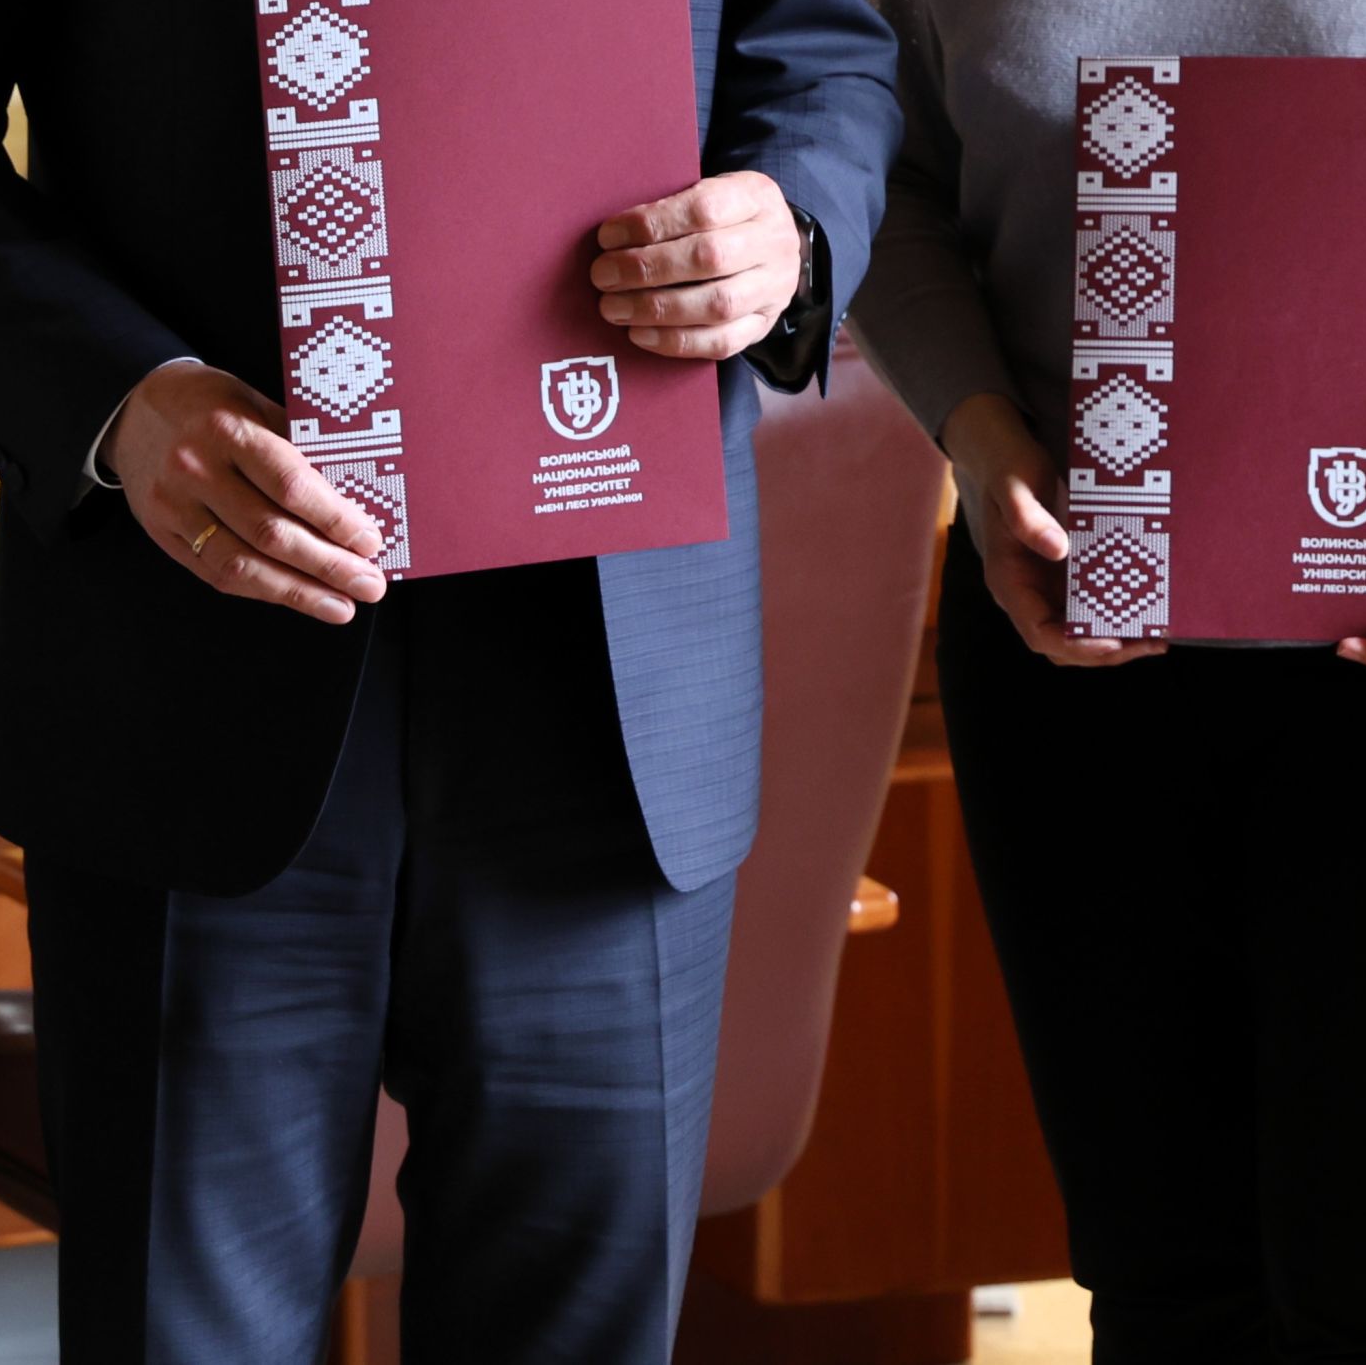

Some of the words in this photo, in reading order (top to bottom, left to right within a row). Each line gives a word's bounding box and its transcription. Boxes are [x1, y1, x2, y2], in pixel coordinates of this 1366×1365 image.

[540, 444, 631, 467] ВОЛИНСЬКИЙ
[532, 459, 641, 484] НАЦІОНАЛЬНИЙ
[543, 478, 631, 499] УНІВЕРСИТЕТ
[534, 501, 563, 514] ІМЕНІ
[565, 498, 589, 510] ЛЕСІ
[590, 492, 643, 507] УКРАЇНКИ
[1292, 584, 1321, 592] ІМЕНІ
[1322, 584, 1346, 594] ЛЕСІ
